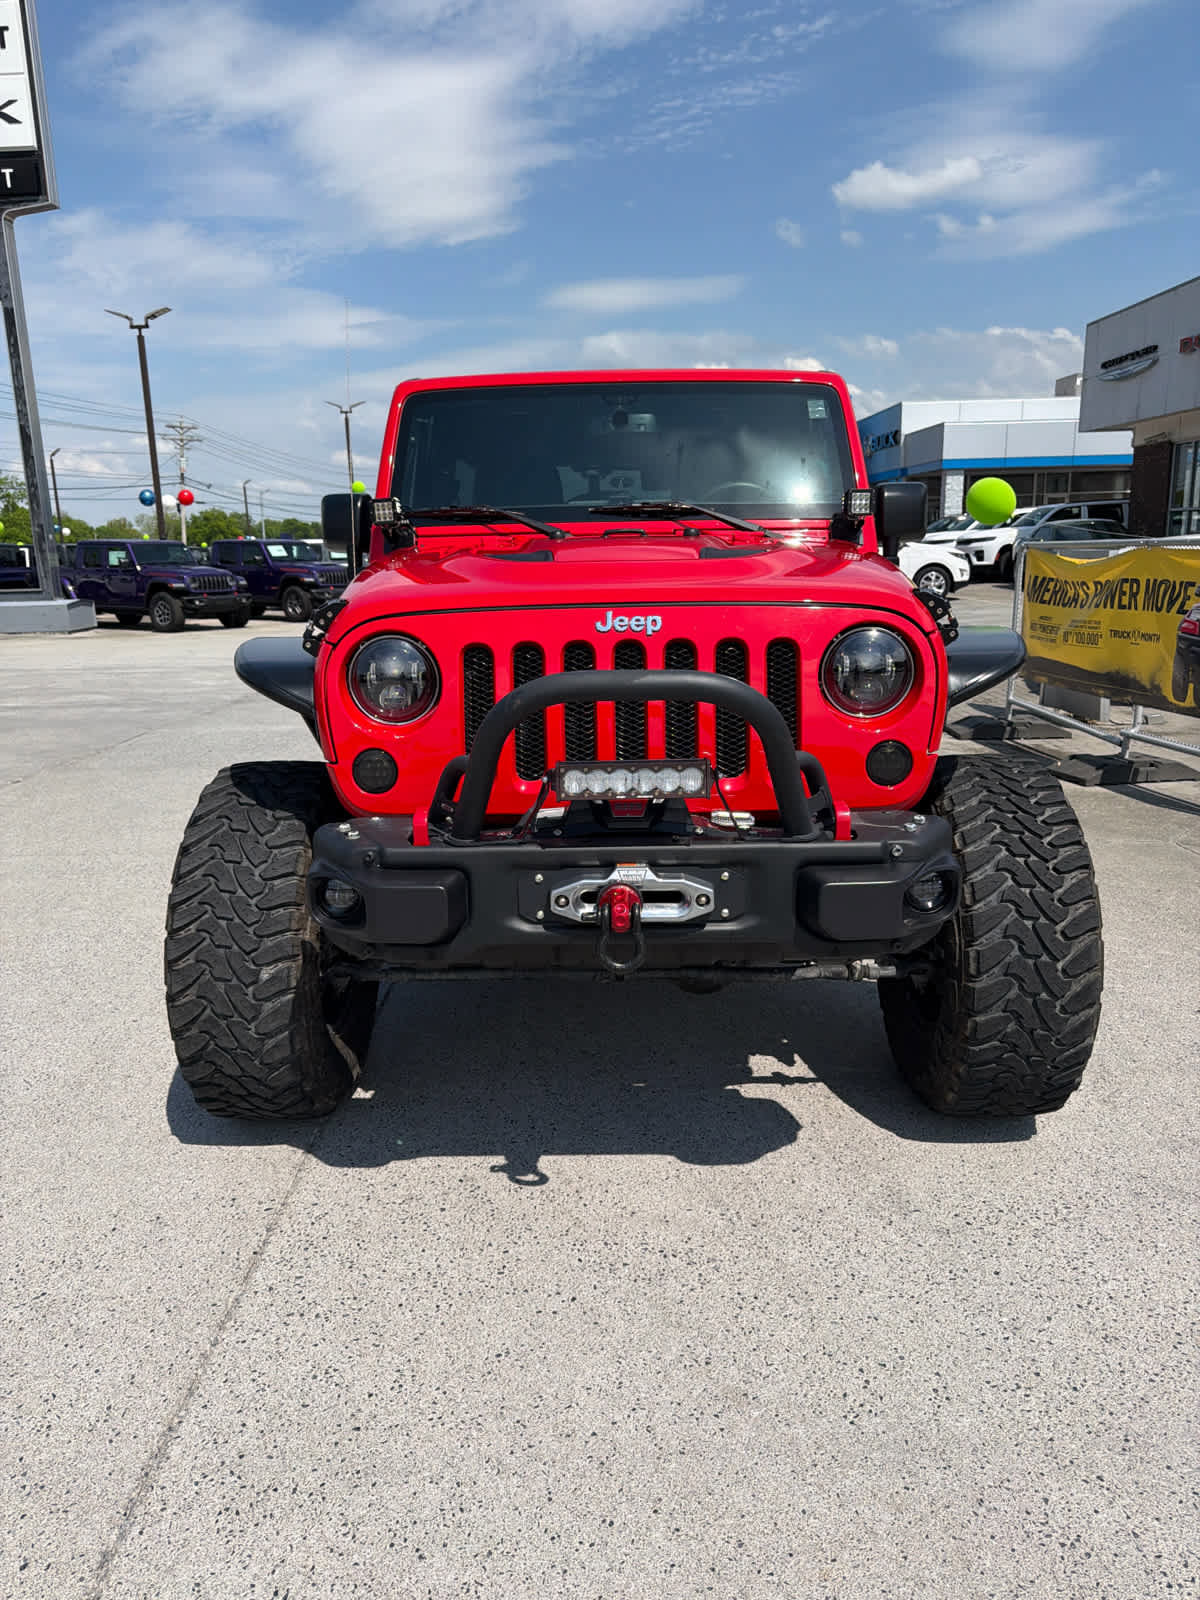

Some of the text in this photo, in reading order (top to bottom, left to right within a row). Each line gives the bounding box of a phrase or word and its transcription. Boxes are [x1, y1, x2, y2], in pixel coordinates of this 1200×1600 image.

[595, 610, 662, 636] Jeep
[1109, 629, 1160, 643] TRUCK MONTH
